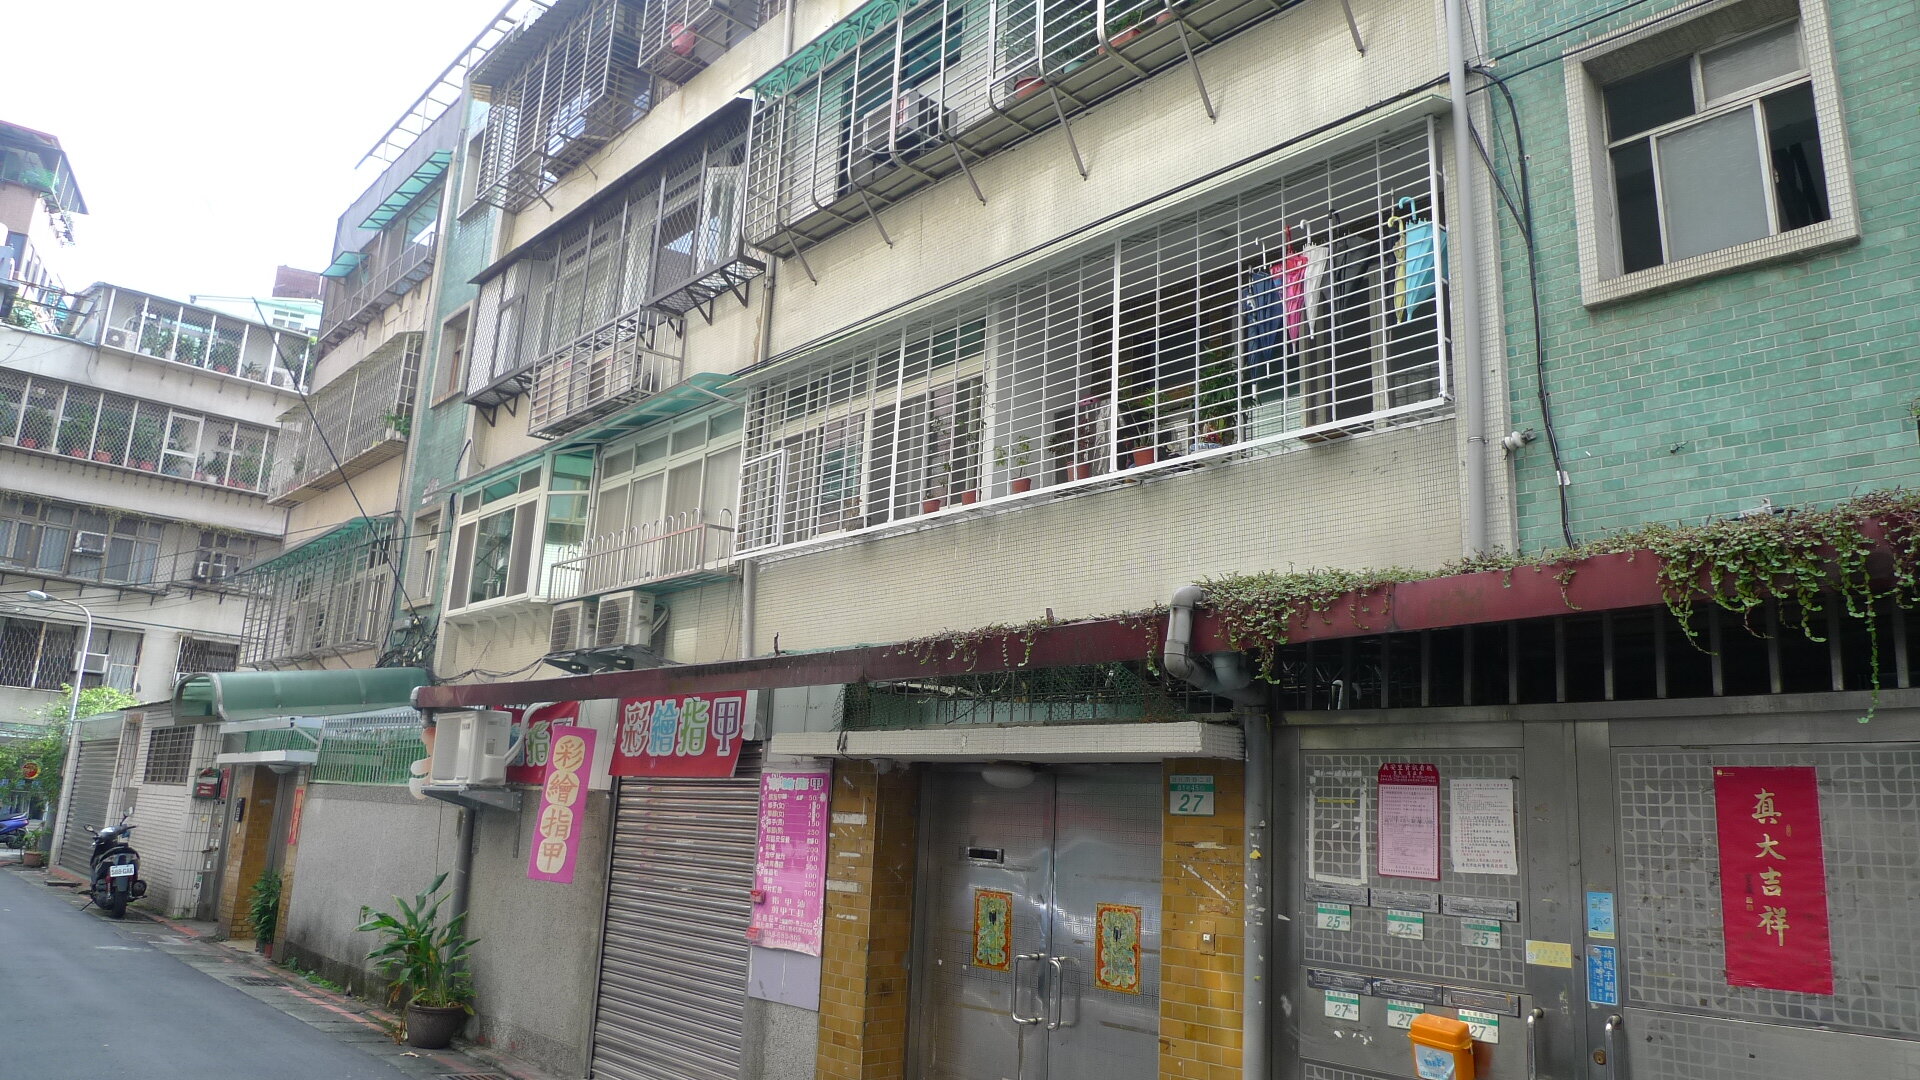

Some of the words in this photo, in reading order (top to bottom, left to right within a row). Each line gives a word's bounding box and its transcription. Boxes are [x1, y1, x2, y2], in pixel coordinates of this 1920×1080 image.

[620, 696, 742, 758] 彩繪指甲
[543, 739, 584, 871] 彩繪指甲
[1178, 793, 1205, 813] 27
[1751, 788, 1790, 947] 真大吉祥
[1326, 916, 1341, 929] 25
[1398, 923, 1413, 935] 25
[1472, 932, 1489, 946] 25
[1603, 949, 1615, 1003] 請隨手關門
[1334, 1004, 1348, 1018] 27
[1397, 1013, 1412, 1027] 27
[1471, 1025, 1487, 1039] 27
